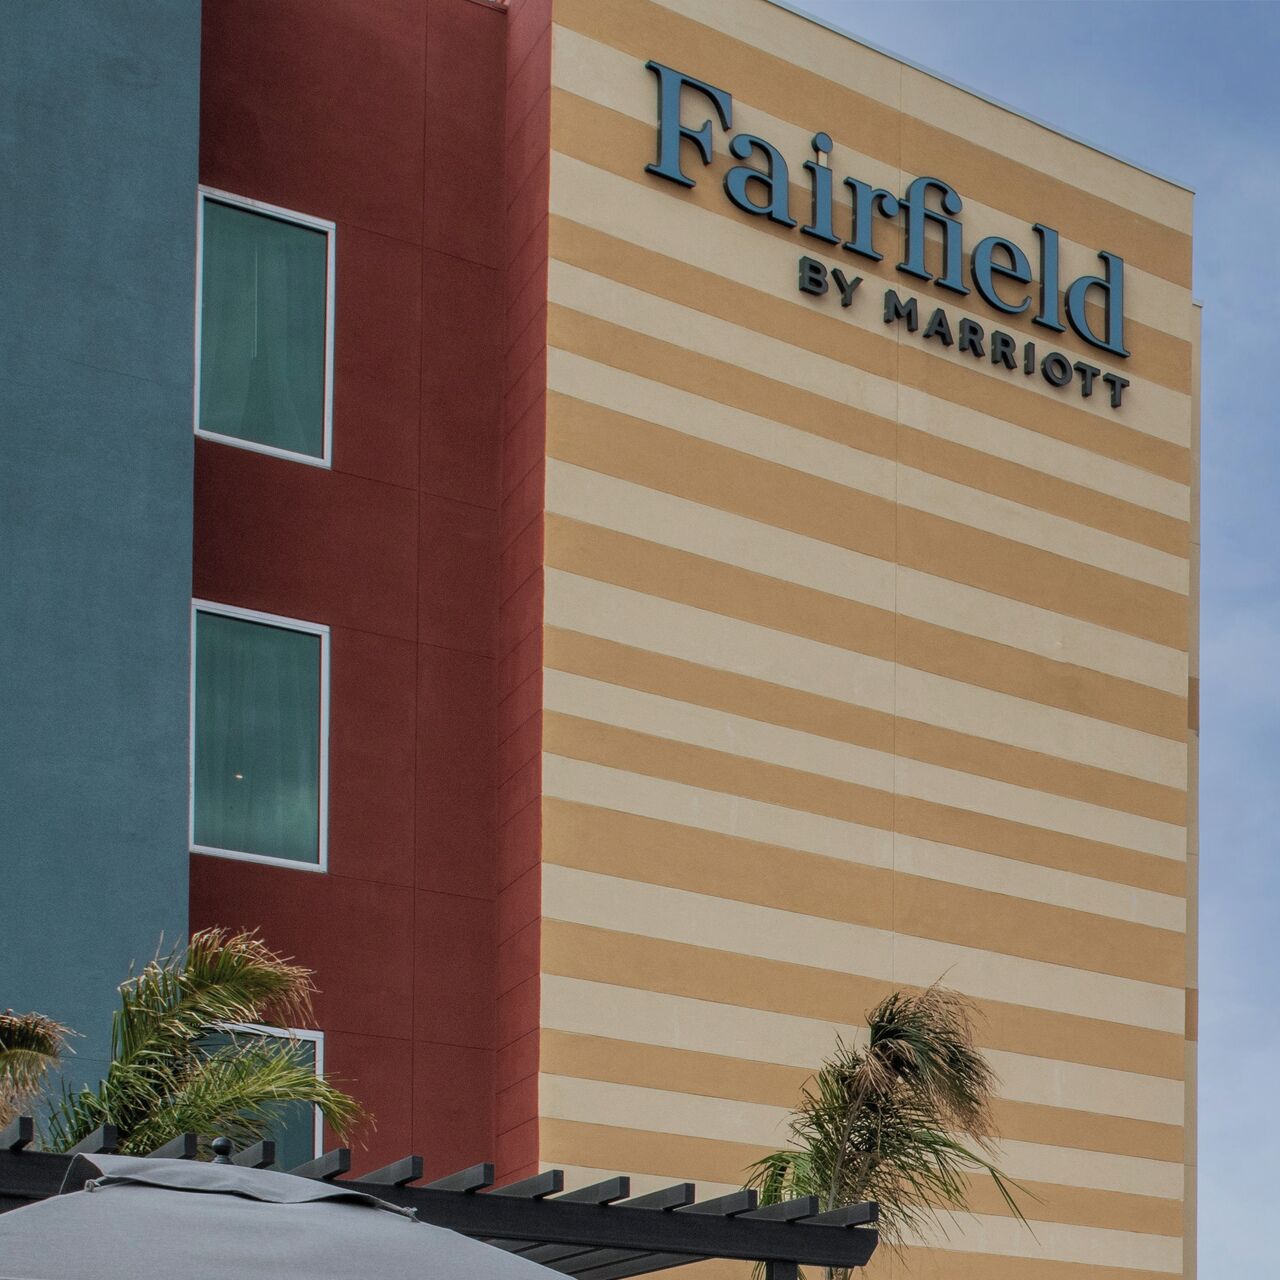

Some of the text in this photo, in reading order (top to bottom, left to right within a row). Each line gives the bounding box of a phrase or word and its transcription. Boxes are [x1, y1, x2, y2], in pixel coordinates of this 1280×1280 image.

[645, 60, 1130, 357] Fairfield
[799, 256, 1130, 408] BY MARRIOTT
